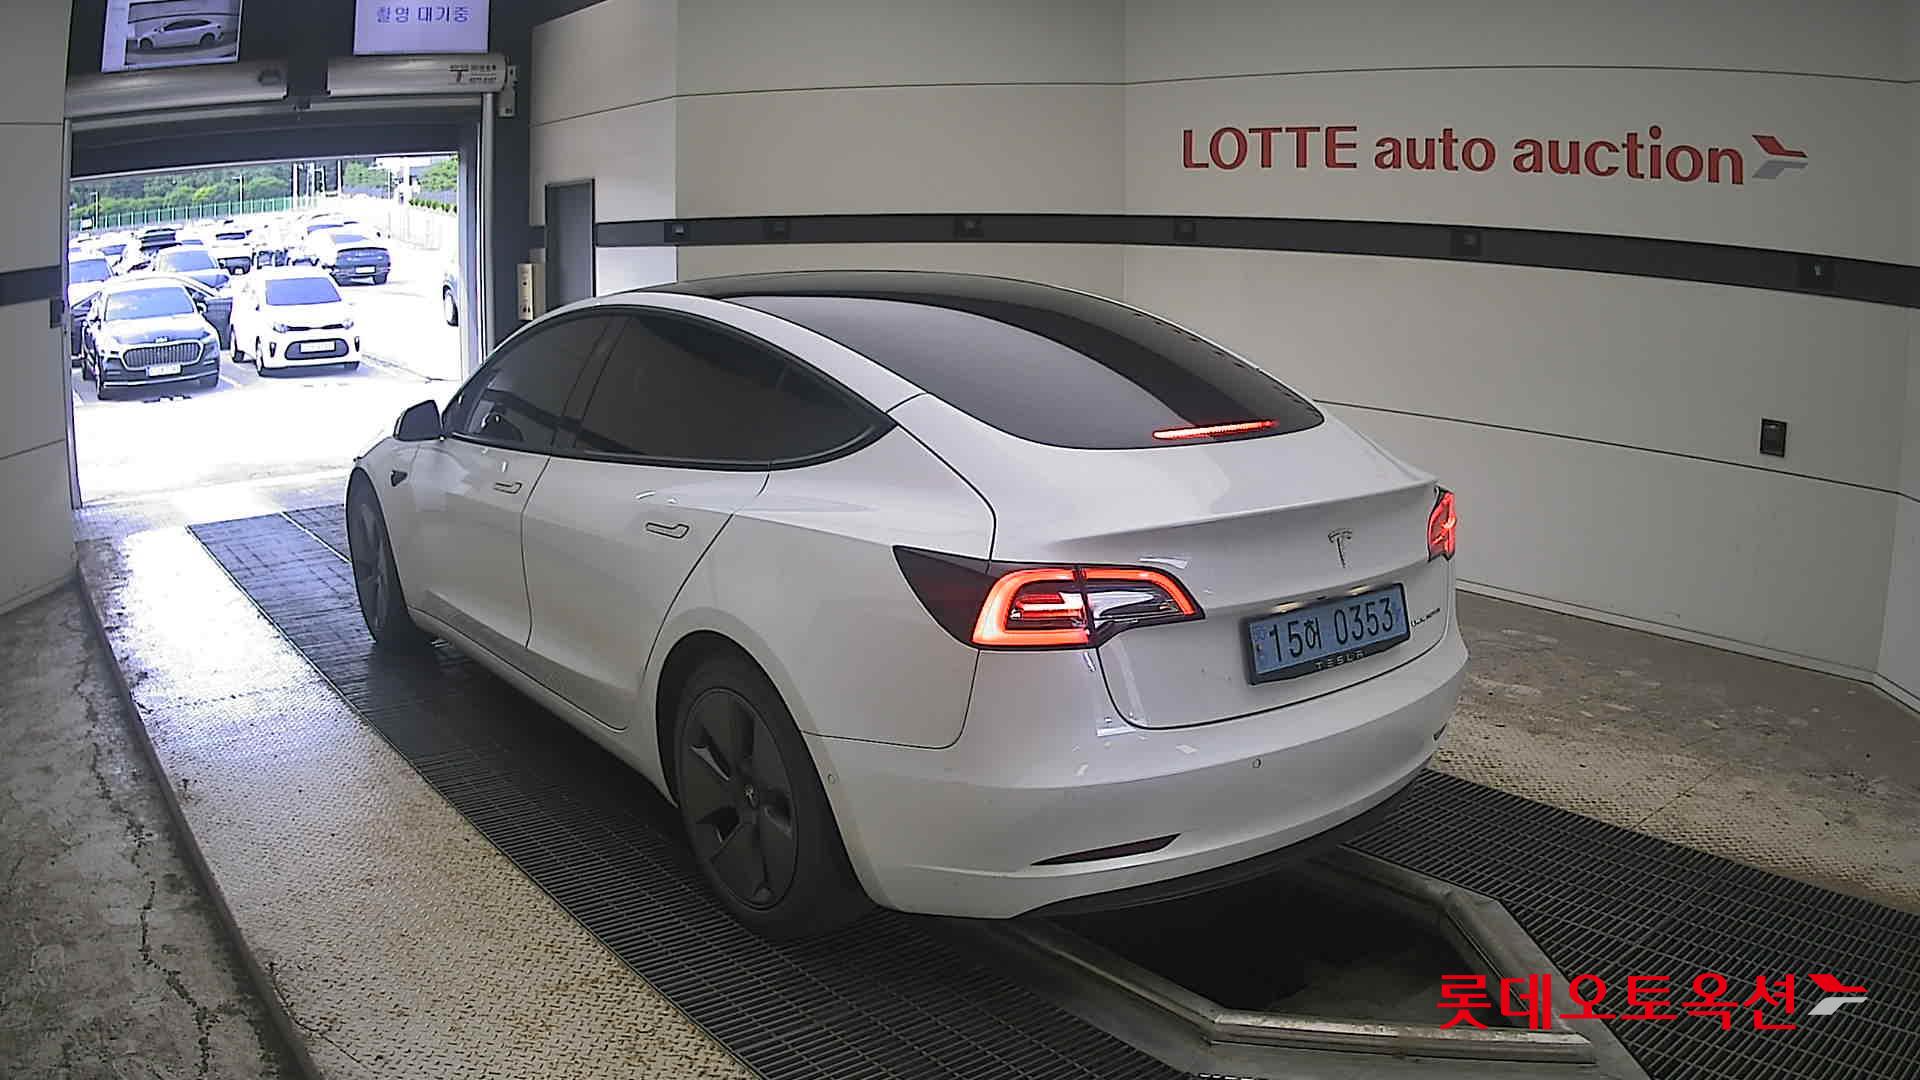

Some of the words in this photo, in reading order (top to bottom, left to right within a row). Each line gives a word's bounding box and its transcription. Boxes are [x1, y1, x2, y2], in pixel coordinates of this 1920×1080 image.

[418, 6, 471, 23] 대기중
[1182, 126, 1358, 170] LOTTE
[1374, 127, 1497, 172] auto
[1512, 125, 1745, 185] auction
[1268, 616, 1323, 663] 15허
[1333, 597, 1394, 645] 0353
